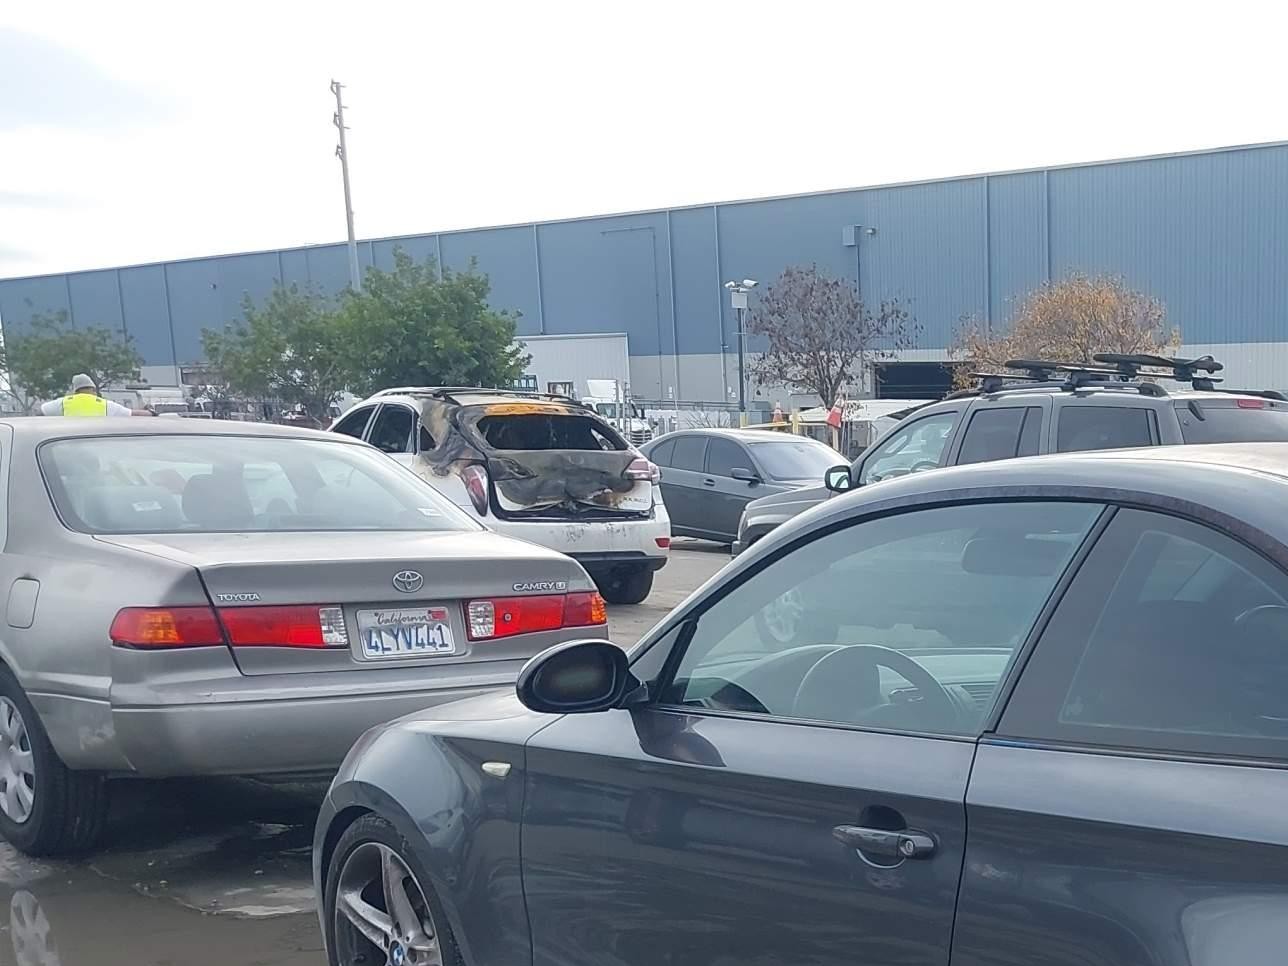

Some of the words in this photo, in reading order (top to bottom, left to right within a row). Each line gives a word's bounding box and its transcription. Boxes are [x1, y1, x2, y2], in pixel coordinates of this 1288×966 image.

[513, 582, 554, 591] CAMRY
[217, 593, 261, 601] TOYOTA
[367, 624, 448, 652] 4LYV441
